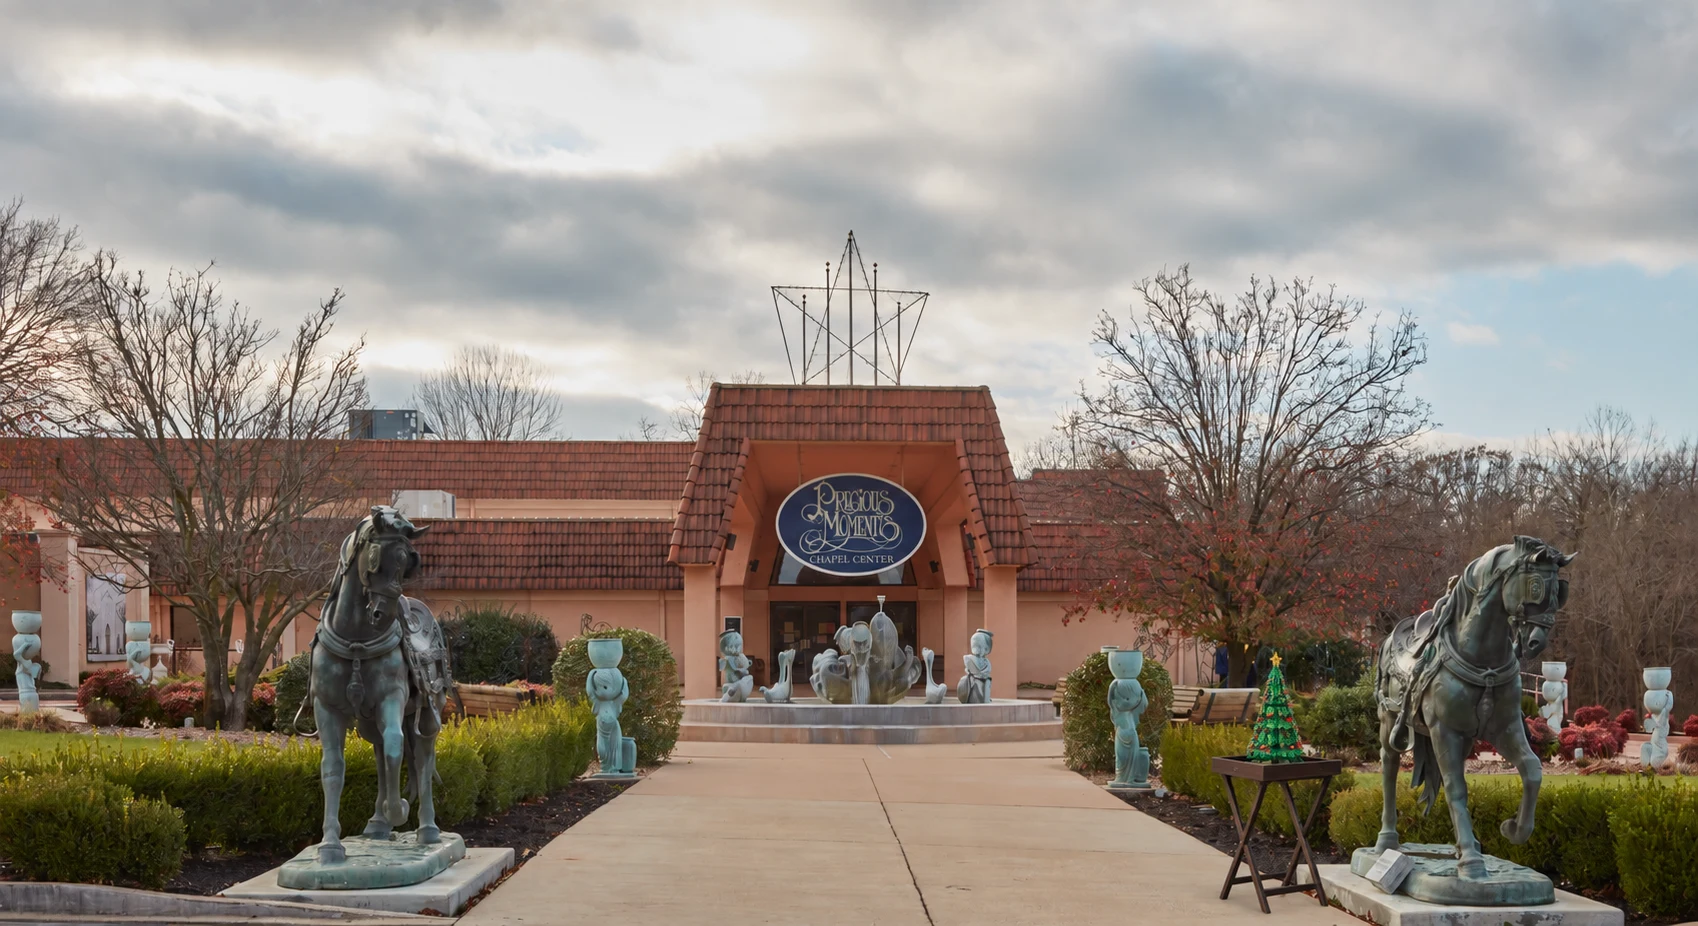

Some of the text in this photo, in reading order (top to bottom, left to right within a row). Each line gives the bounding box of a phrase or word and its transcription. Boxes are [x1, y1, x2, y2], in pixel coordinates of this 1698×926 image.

[803, 511, 903, 551] MOMENTS
[809, 555, 894, 564] CHAPEL CENTER
